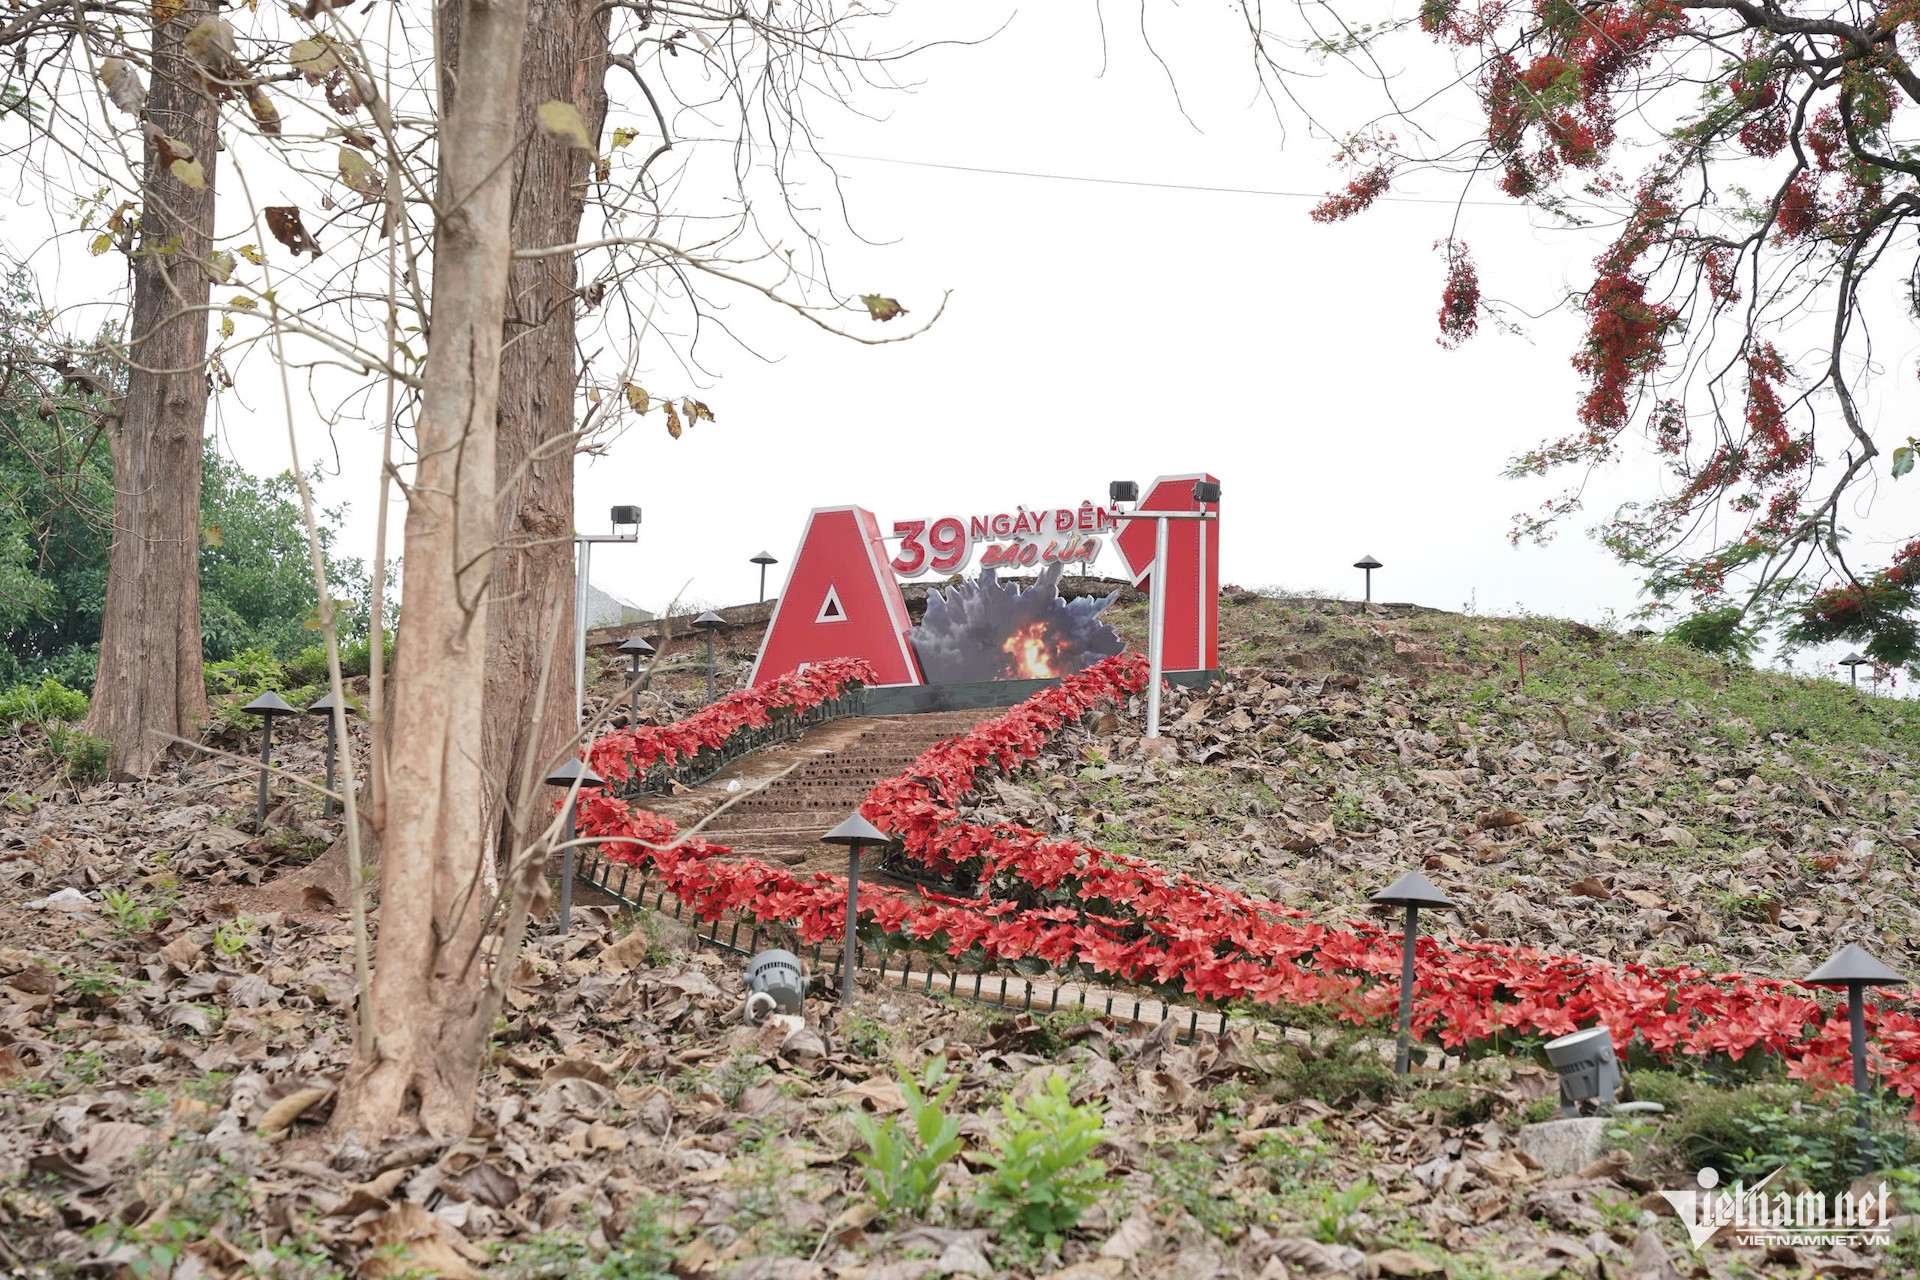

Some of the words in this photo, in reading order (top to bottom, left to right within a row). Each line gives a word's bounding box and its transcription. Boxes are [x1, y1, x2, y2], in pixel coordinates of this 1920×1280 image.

[970, 504, 1048, 537] NGÀY
[1054, 499, 1118, 532] ĐÊM
[890, 517, 966, 573] 39
[980, 536, 1038, 564] BÃO
[1042, 531, 1097, 560] LỬA
[746, 504, 924, 689] A
[1111, 473, 1220, 672] 1
